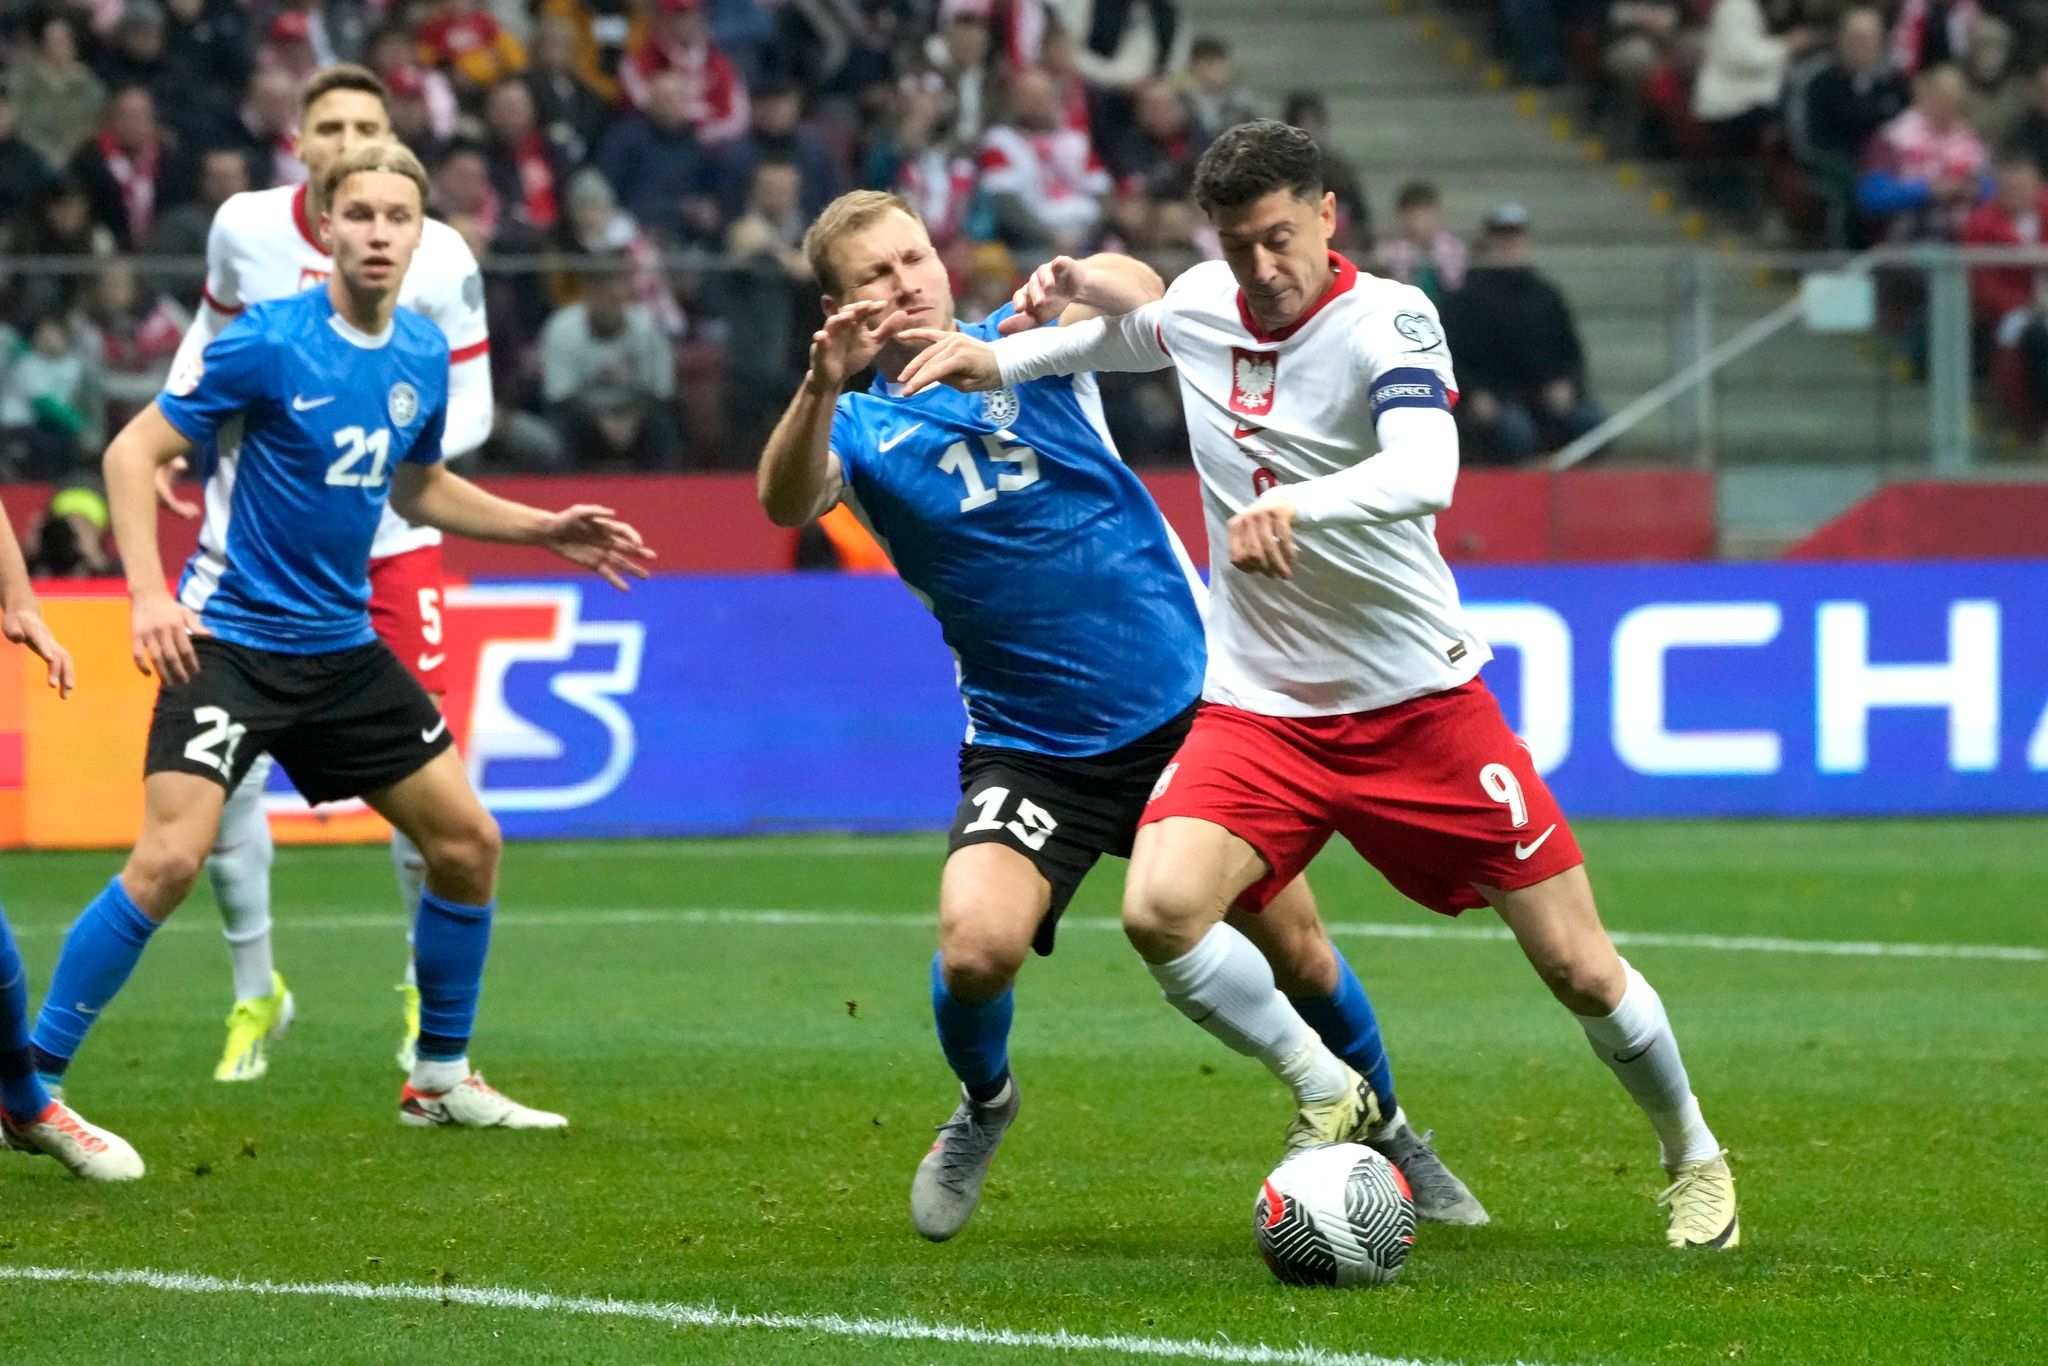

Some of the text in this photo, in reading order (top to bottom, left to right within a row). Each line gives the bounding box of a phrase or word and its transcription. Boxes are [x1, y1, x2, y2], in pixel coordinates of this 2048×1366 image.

[324, 425, 391, 487] 21
[937, 429, 1040, 513] 15
[418, 588, 442, 644] 5
[184, 705, 247, 781] 21
[963, 786, 1058, 851] 15
[1479, 763, 1528, 828] 9
